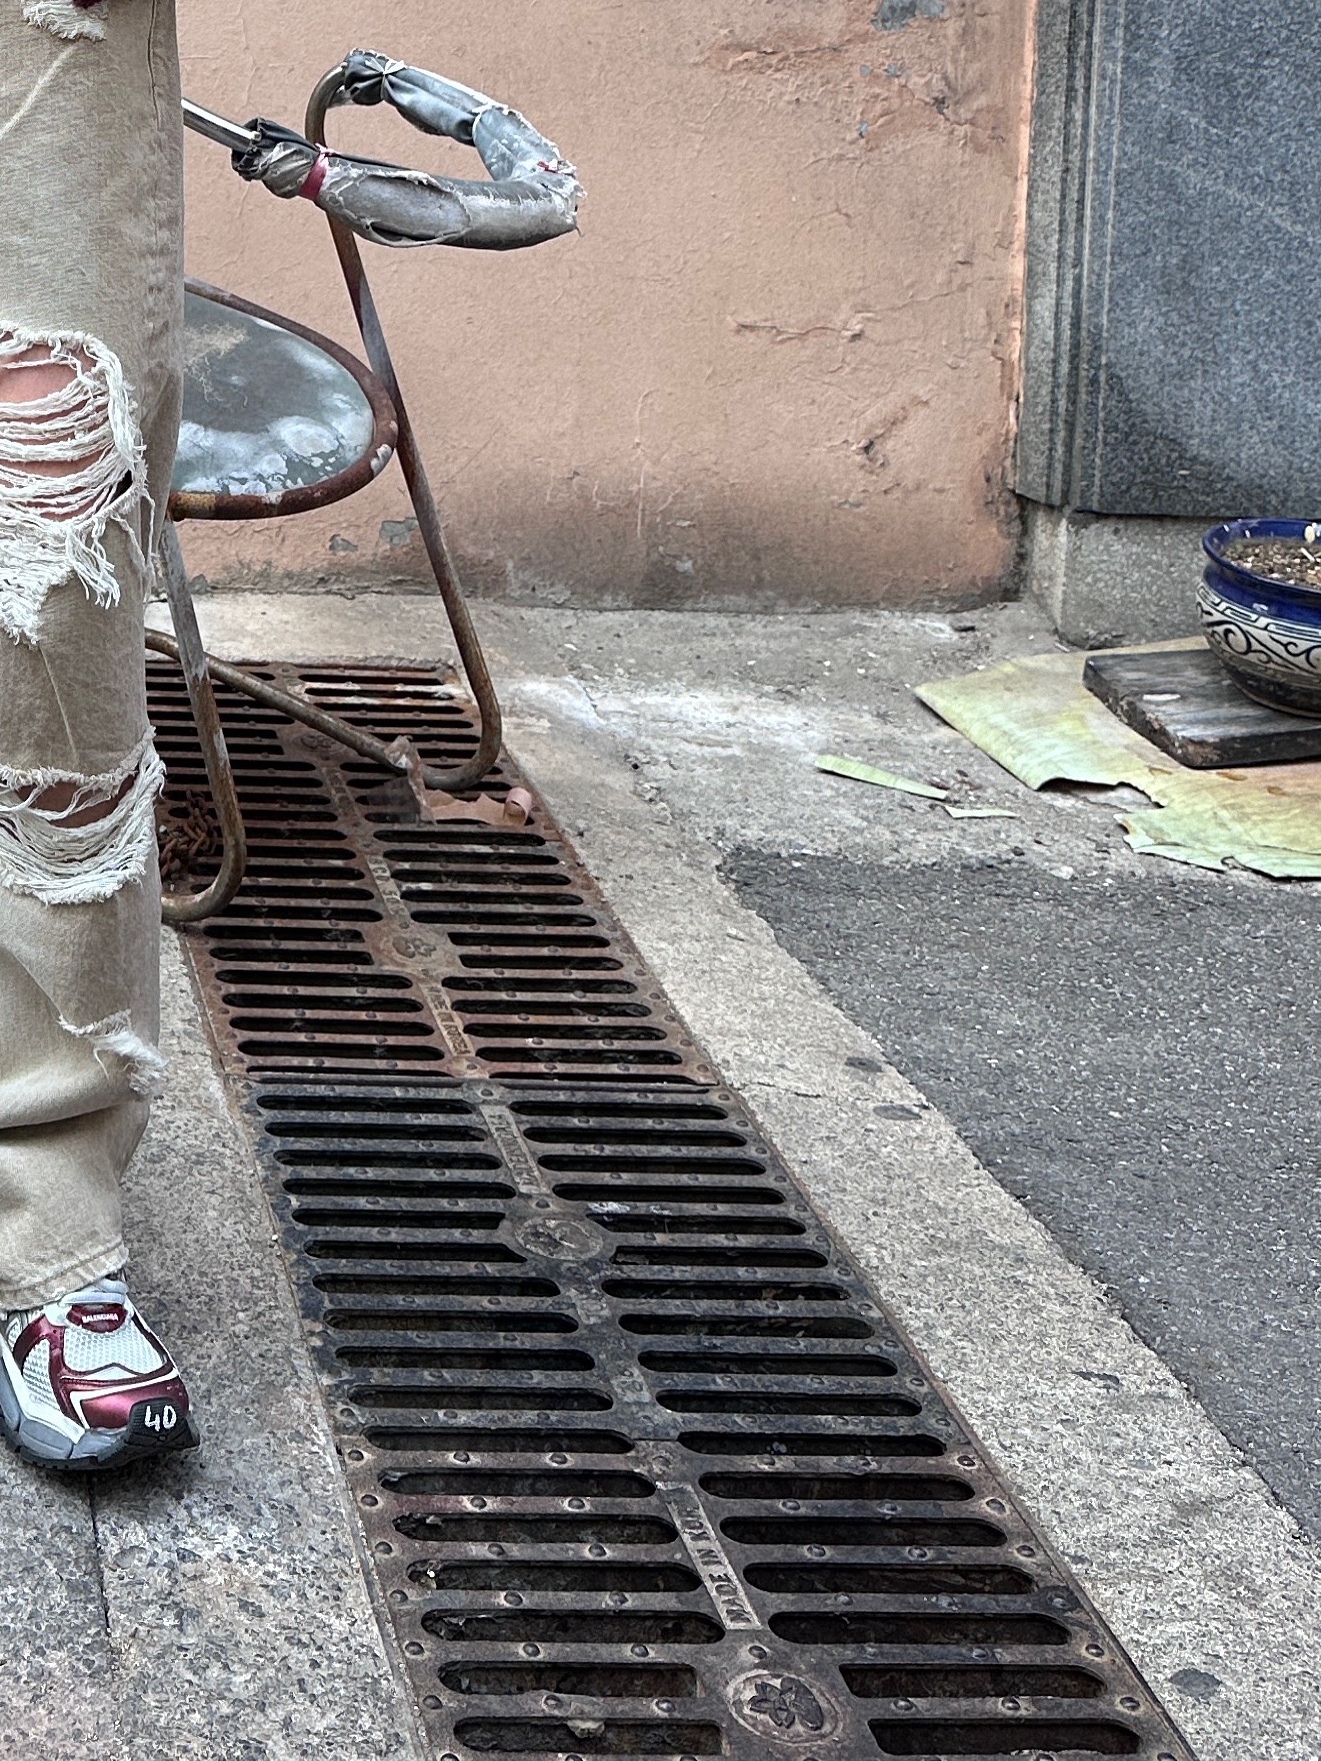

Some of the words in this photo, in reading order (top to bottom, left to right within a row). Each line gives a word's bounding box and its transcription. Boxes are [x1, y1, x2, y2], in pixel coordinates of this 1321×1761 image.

[144, 1405, 177, 1432] 40
[695, 1548, 724, 1566] IN
[706, 1572, 751, 1624] MADE
